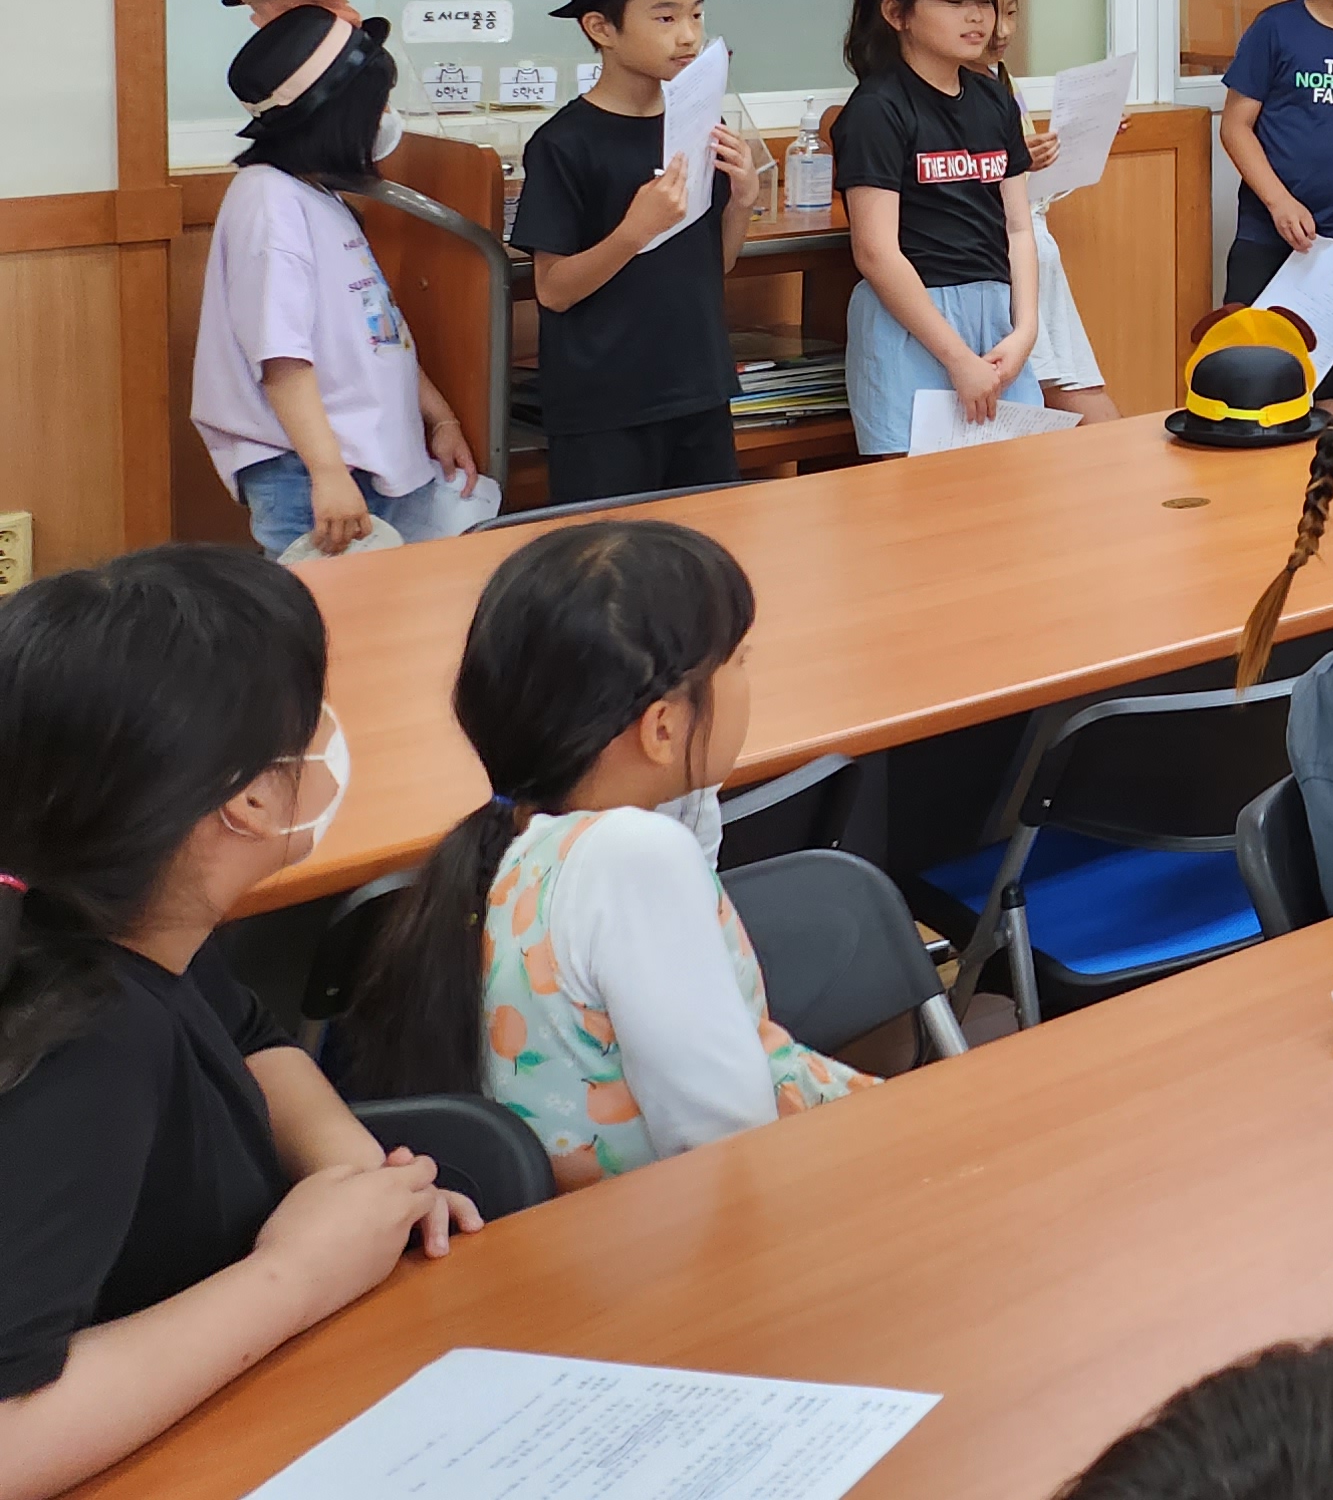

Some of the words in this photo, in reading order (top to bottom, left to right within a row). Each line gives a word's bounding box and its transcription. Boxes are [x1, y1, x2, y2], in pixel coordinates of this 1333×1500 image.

[422, 10, 498, 30] 도서대출증
[435, 86, 469, 101] 6학년
[512, 86, 545, 101] 5학년
